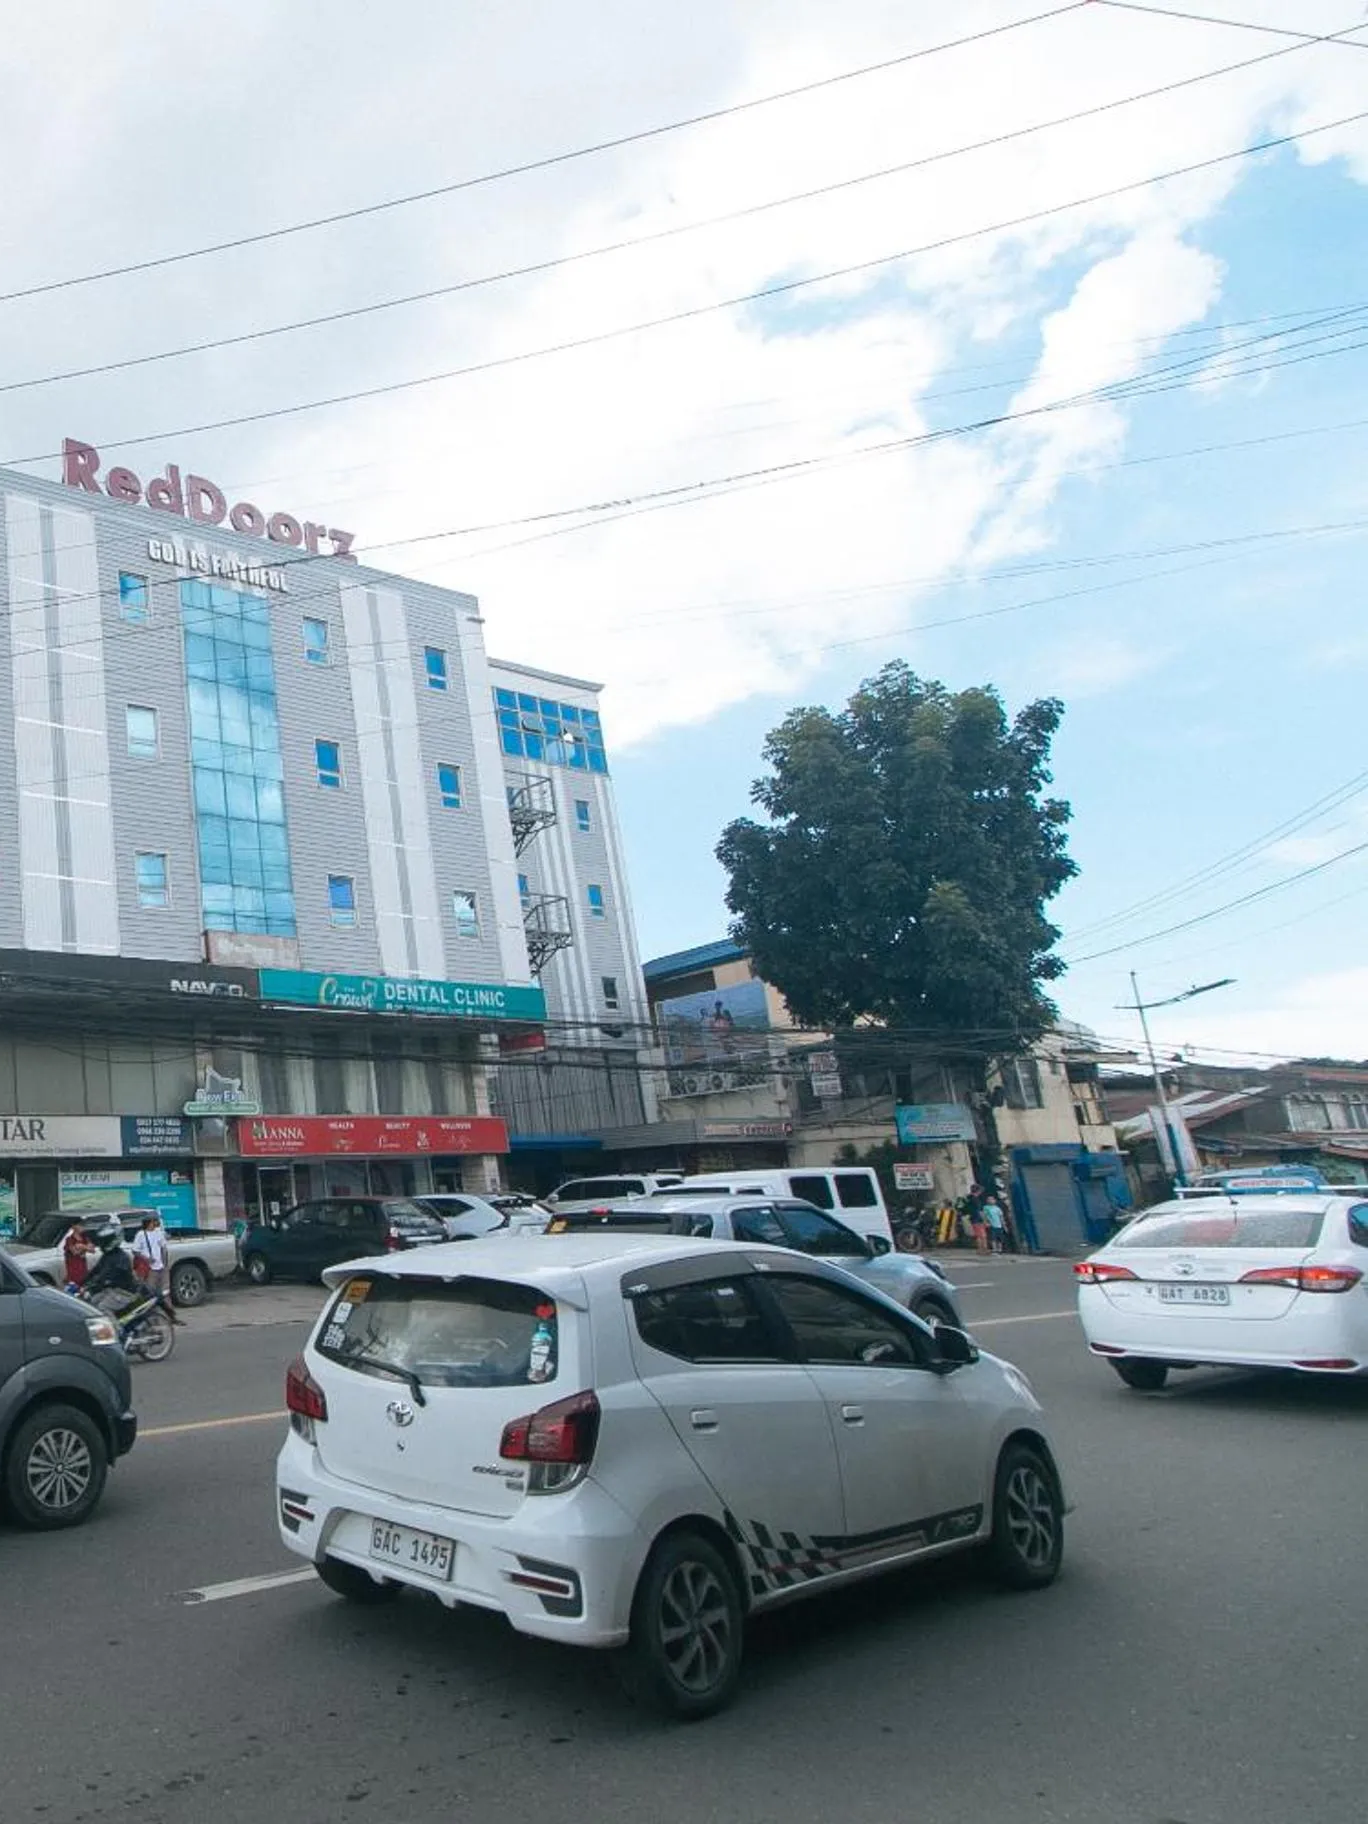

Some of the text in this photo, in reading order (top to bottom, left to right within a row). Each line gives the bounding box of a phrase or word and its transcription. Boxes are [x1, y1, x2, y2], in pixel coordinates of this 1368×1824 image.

[62, 437, 358, 565] RedDoorz
[211, 552, 291, 594] FAITHFUL
[384, 982, 450, 1005] DENTAL
[454, 987, 506, 1008] CLINIC
[373, 1527, 448, 1569] GAC 1495
